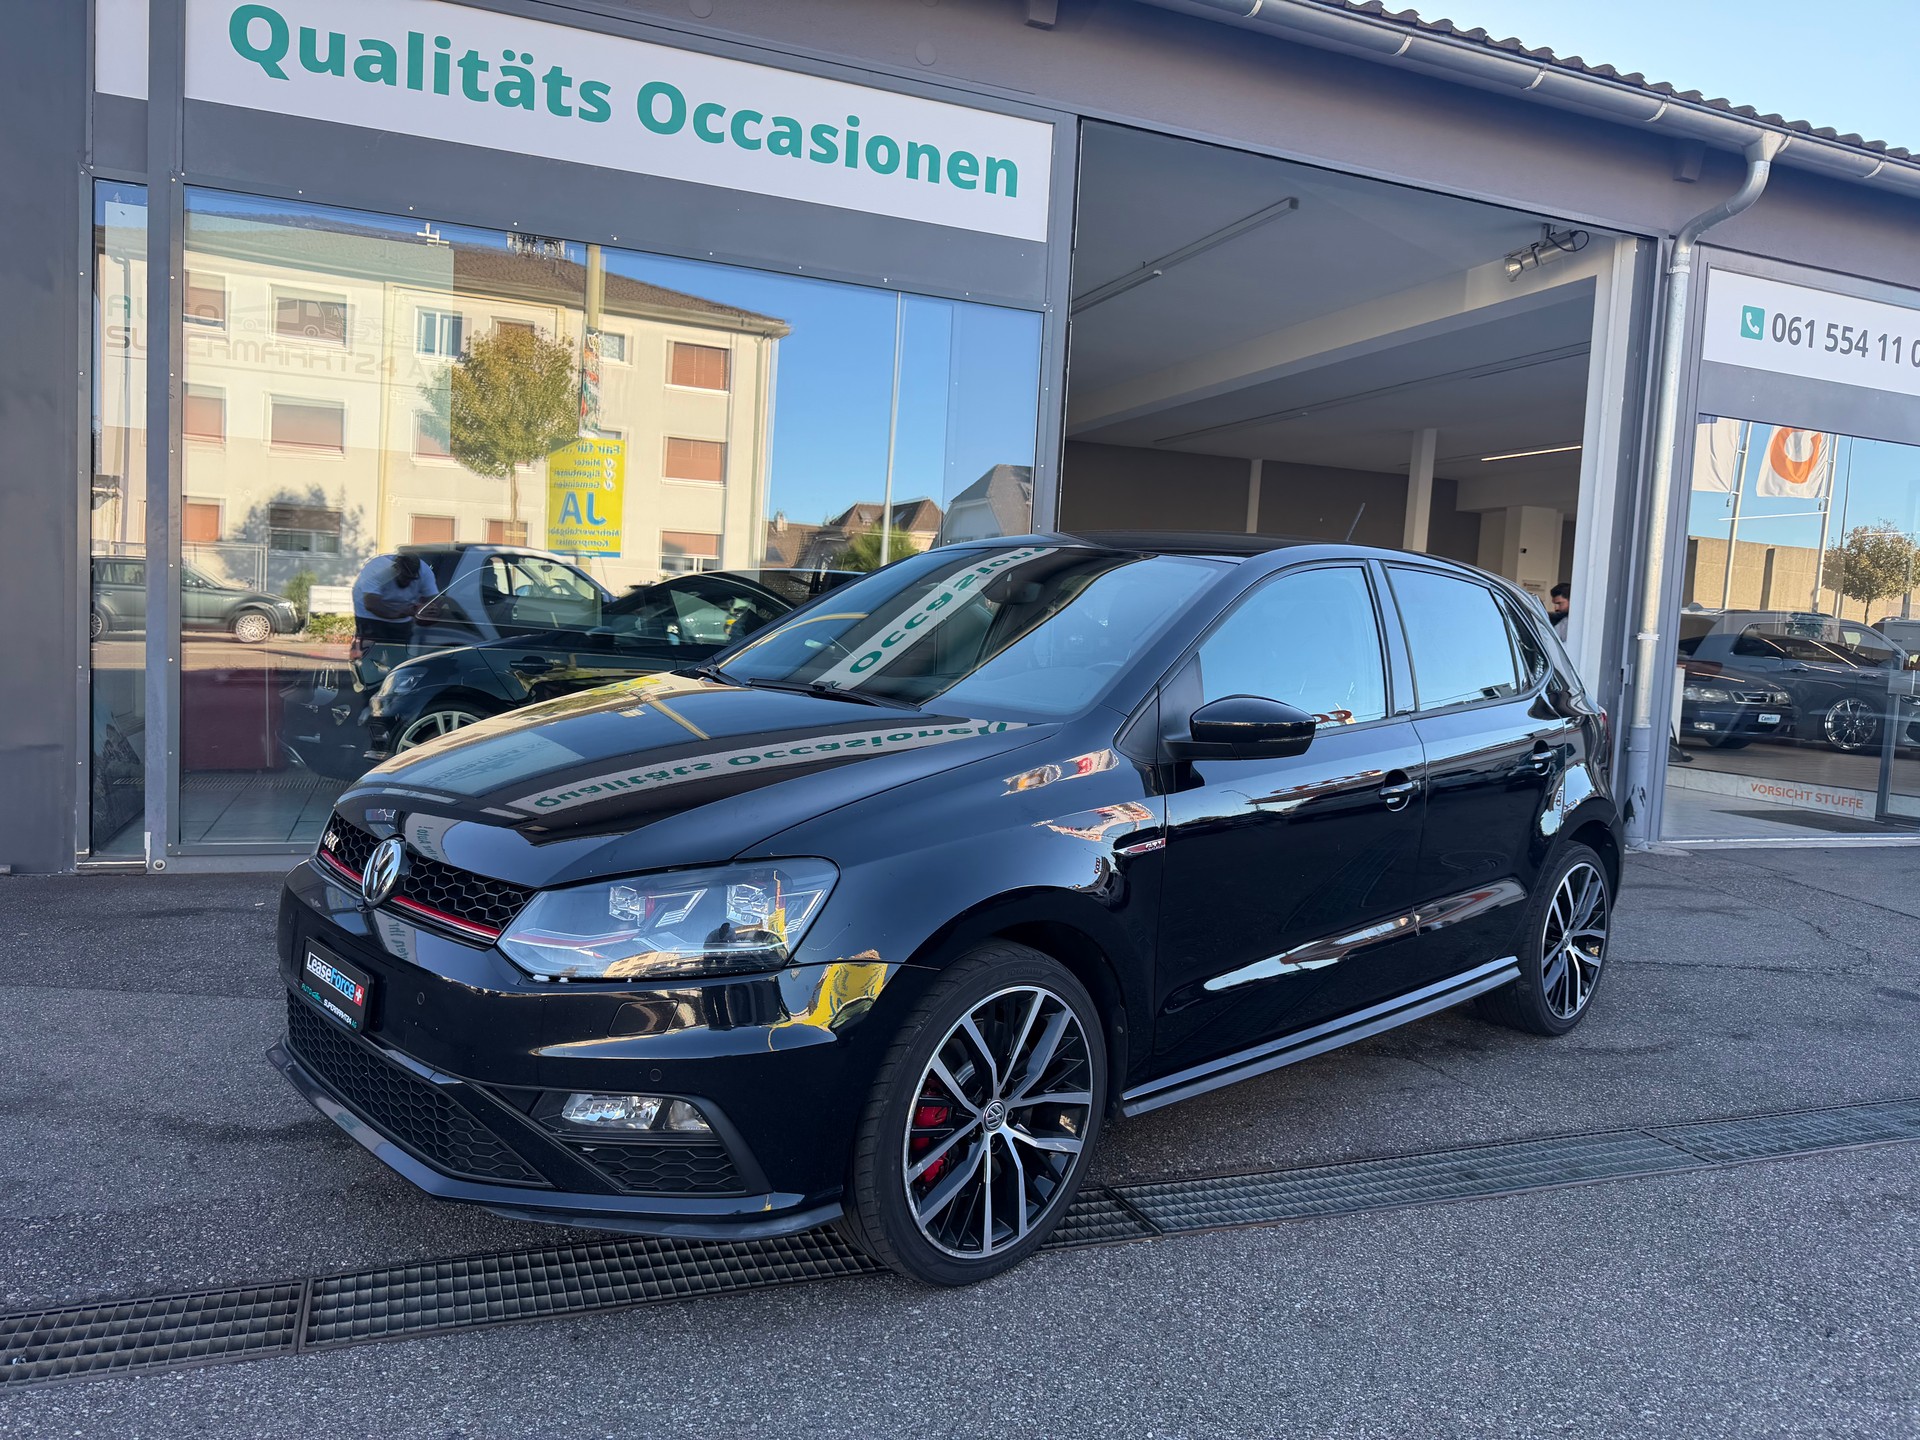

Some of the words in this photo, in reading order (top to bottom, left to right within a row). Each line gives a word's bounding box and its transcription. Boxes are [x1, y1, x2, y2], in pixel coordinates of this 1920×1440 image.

[228, 4, 612, 124] Qualitäts
[636, 81, 1018, 198] Occasionen
[1772, 313, 1815, 348] 061
[1824, 323, 1868, 358] 554
[1878, 333, 1902, 364] 11
[1751, 783, 1813, 801] VORSICHT
[1815, 792, 1864, 809] STUFFE
[306, 951, 356, 999] LeaseForce
